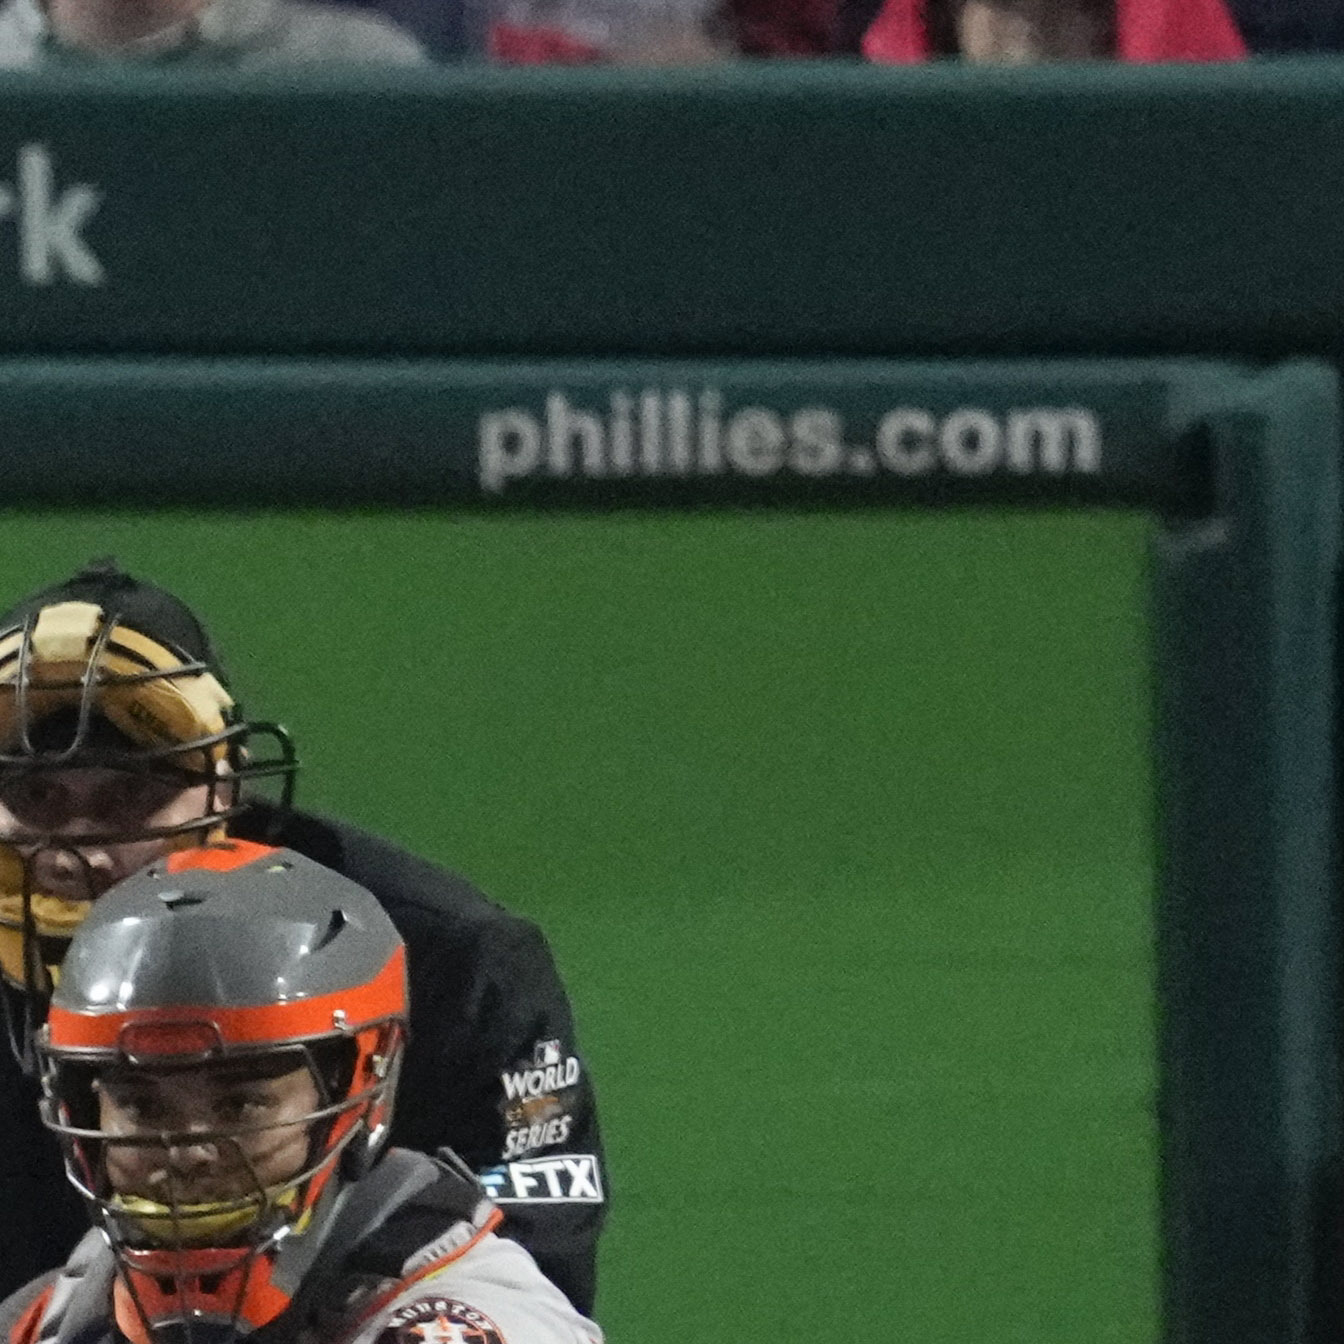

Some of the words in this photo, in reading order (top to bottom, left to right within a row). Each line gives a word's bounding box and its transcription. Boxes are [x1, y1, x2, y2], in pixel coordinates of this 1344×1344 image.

[479, 389, 1102, 494] phillies.com
[502, 1056, 580, 1100] WORLD
[502, 1115, 572, 1160] SERIES
[509, 1159, 598, 1198] FTX
